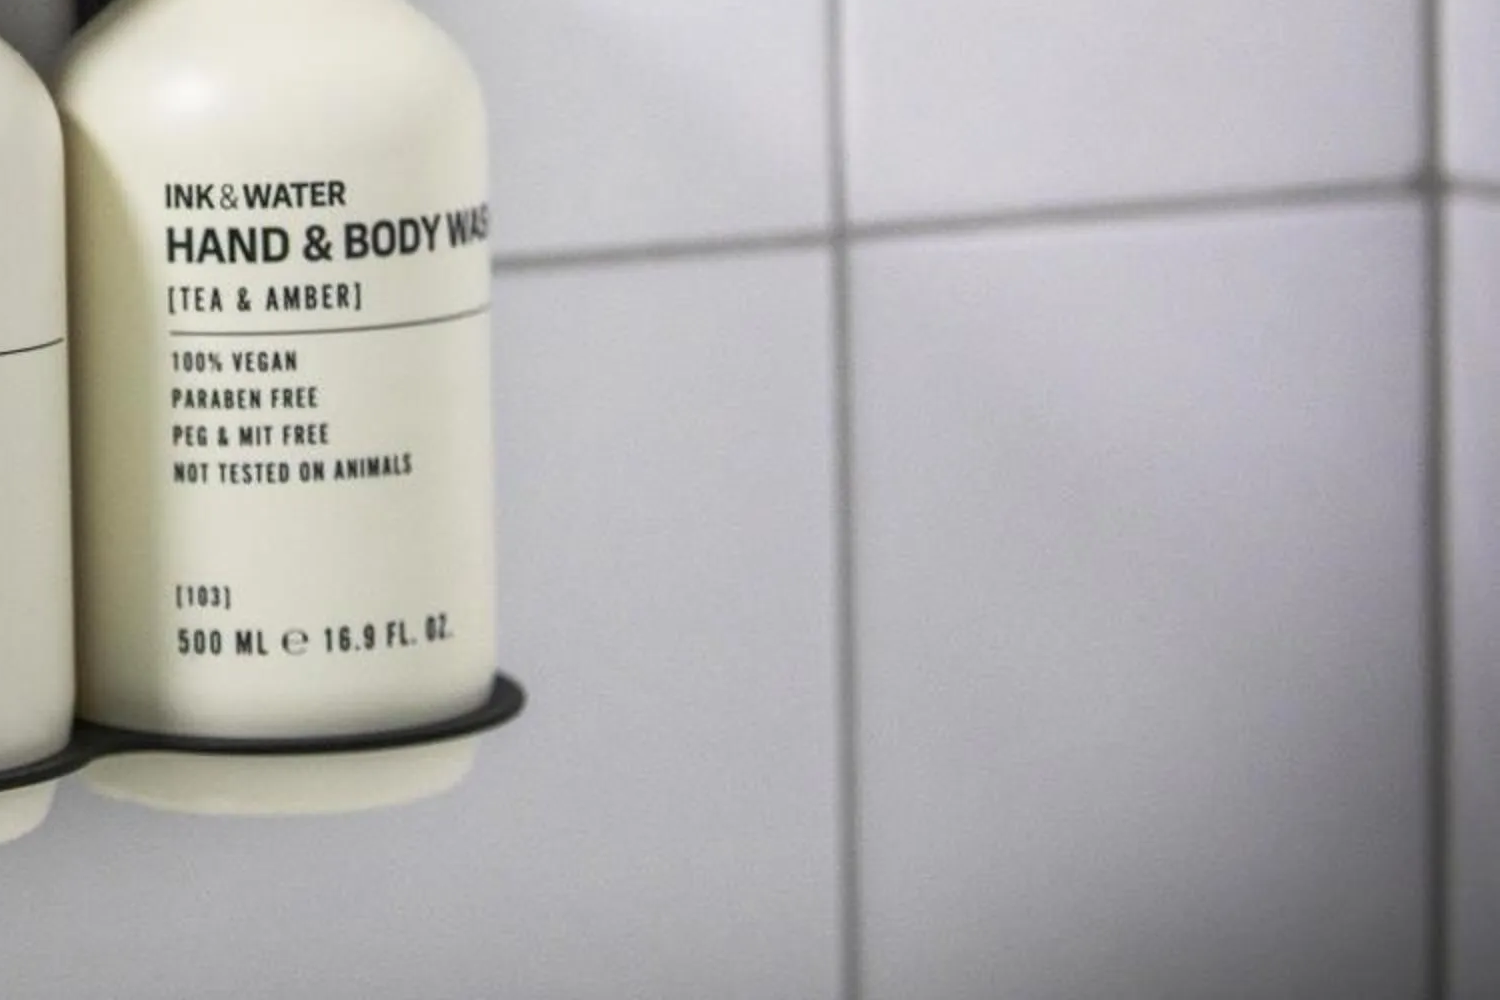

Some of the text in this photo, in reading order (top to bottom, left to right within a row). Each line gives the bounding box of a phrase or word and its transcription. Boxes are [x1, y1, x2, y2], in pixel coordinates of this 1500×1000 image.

[164, 179, 347, 211] INK&WATER
[165, 225, 291, 265] HAND
[301, 223, 333, 263] &
[343, 212, 441, 261] BODY
[167, 281, 362, 315] [TEA & AMBER]
[171, 350, 298, 374] 100% VEGAN
[171, 385, 318, 411] PARABEN FREE
[171, 422, 329, 448] PEG & MIT FREE
[173, 452, 413, 485] NOT TESTED ON ANIMALS
[175, 584, 232, 611] [103]
[177, 628, 223, 657] 500
[234, 629, 269, 657] ML
[323, 623, 376, 653] 16.9
[385, 619, 417, 649] FL.
[424, 612, 452, 643] OZ.
